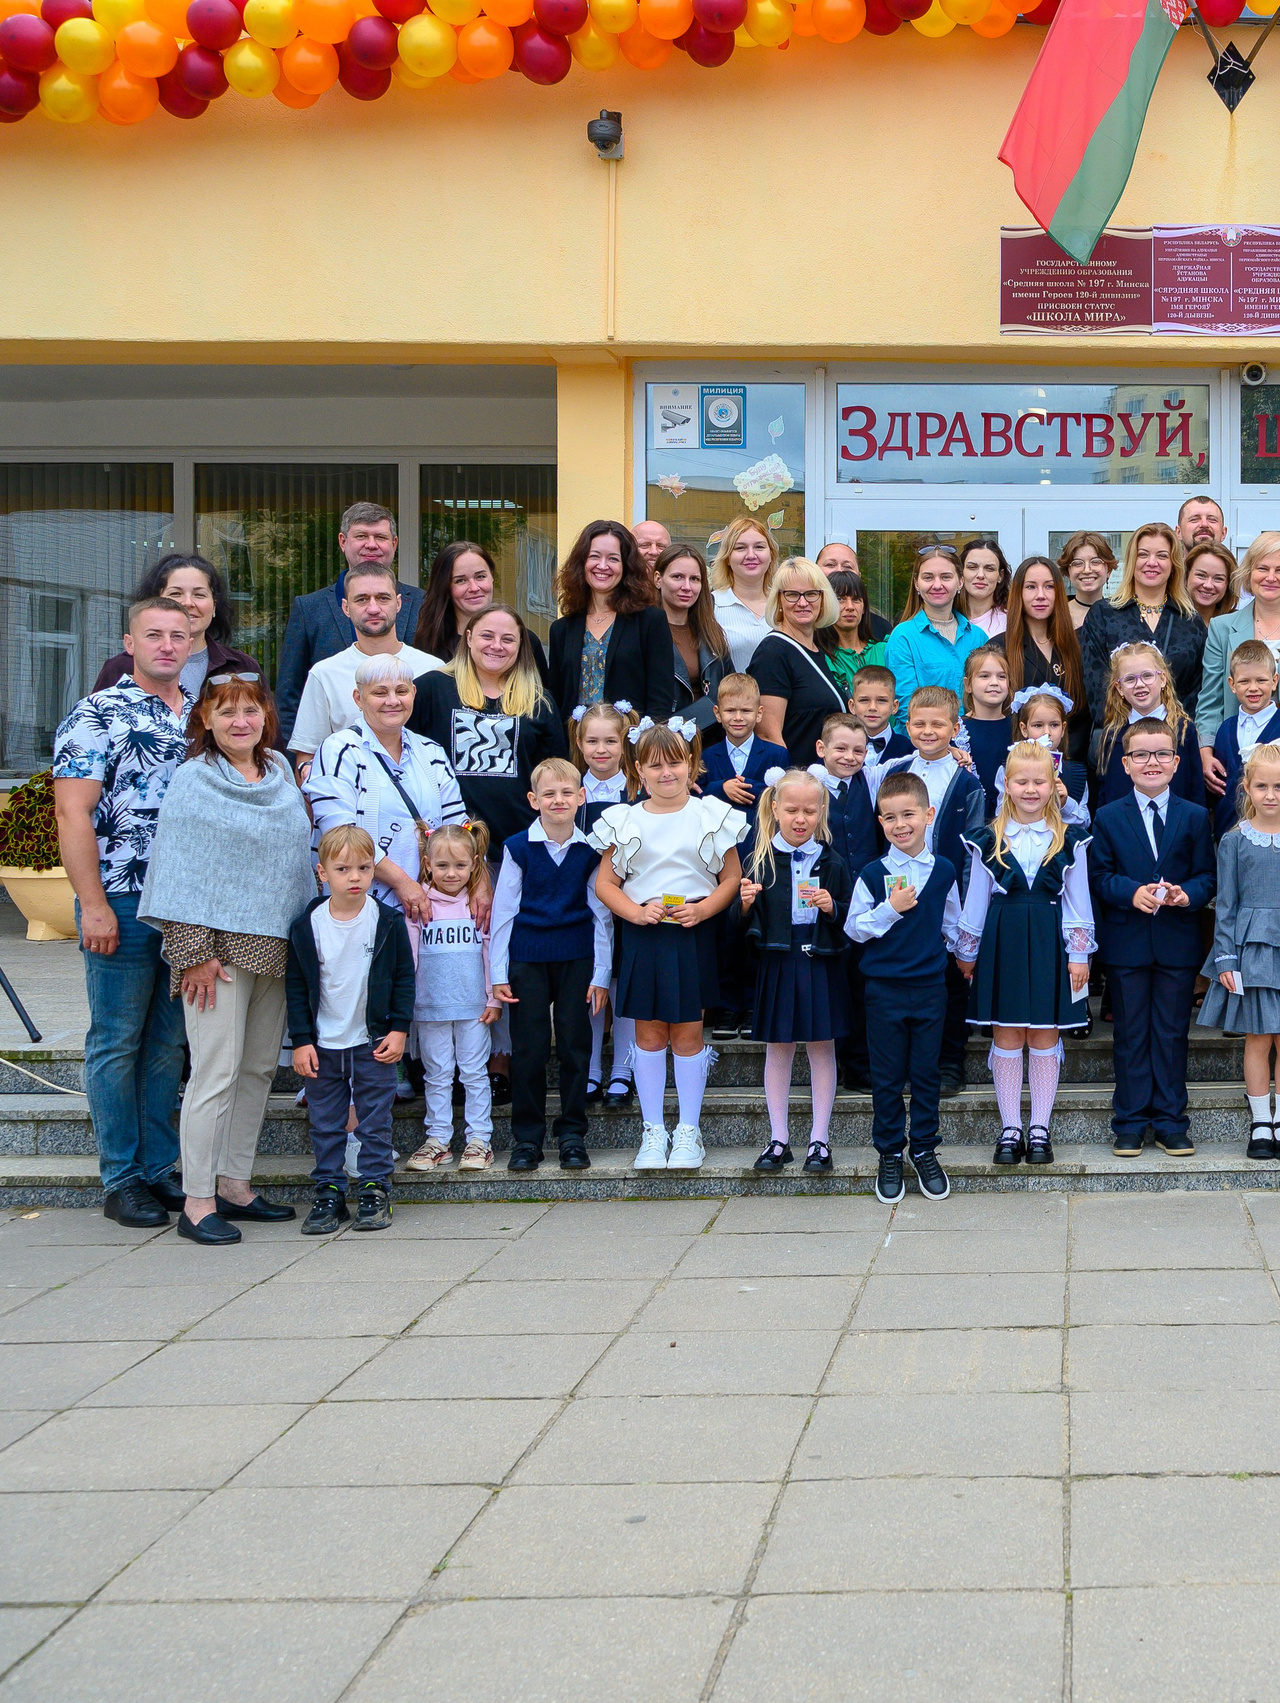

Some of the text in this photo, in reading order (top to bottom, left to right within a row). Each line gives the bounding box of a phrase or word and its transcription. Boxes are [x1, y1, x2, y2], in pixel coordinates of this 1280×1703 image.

[1003, 279, 1044, 288] «Средняя
[1077, 280, 1086, 288] №
[1116, 280, 1150, 288] Минска
[1042, 291, 1073, 299] Героев
[1075, 291, 1098, 299] 120-й
[1154, 287, 1199, 295] «СЯРЭДНЯЯ
[1037, 302, 1083, 310] ПРИСВОЕН
[1026, 312, 1126, 321] «ШКОЛА МИРА»
[703, 387, 744, 395] МИЛИЦИЯ
